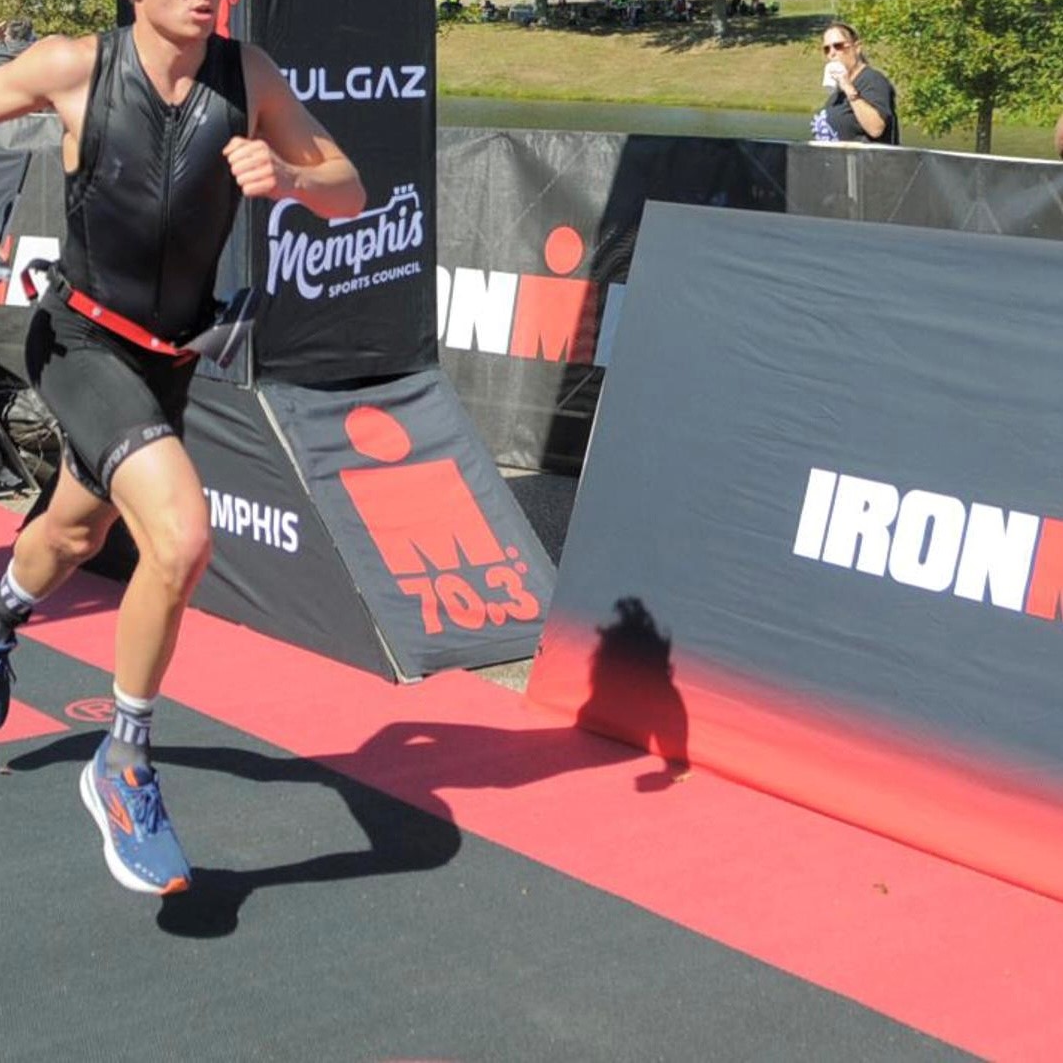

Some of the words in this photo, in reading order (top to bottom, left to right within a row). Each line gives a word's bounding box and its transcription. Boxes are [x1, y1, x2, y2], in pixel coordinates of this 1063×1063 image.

[266, 204, 424, 300] Memphis
[328, 276, 371, 299] SPORTS
[371, 260, 422, 284] COUNCIL
[396, 566, 540, 636] 70.3
